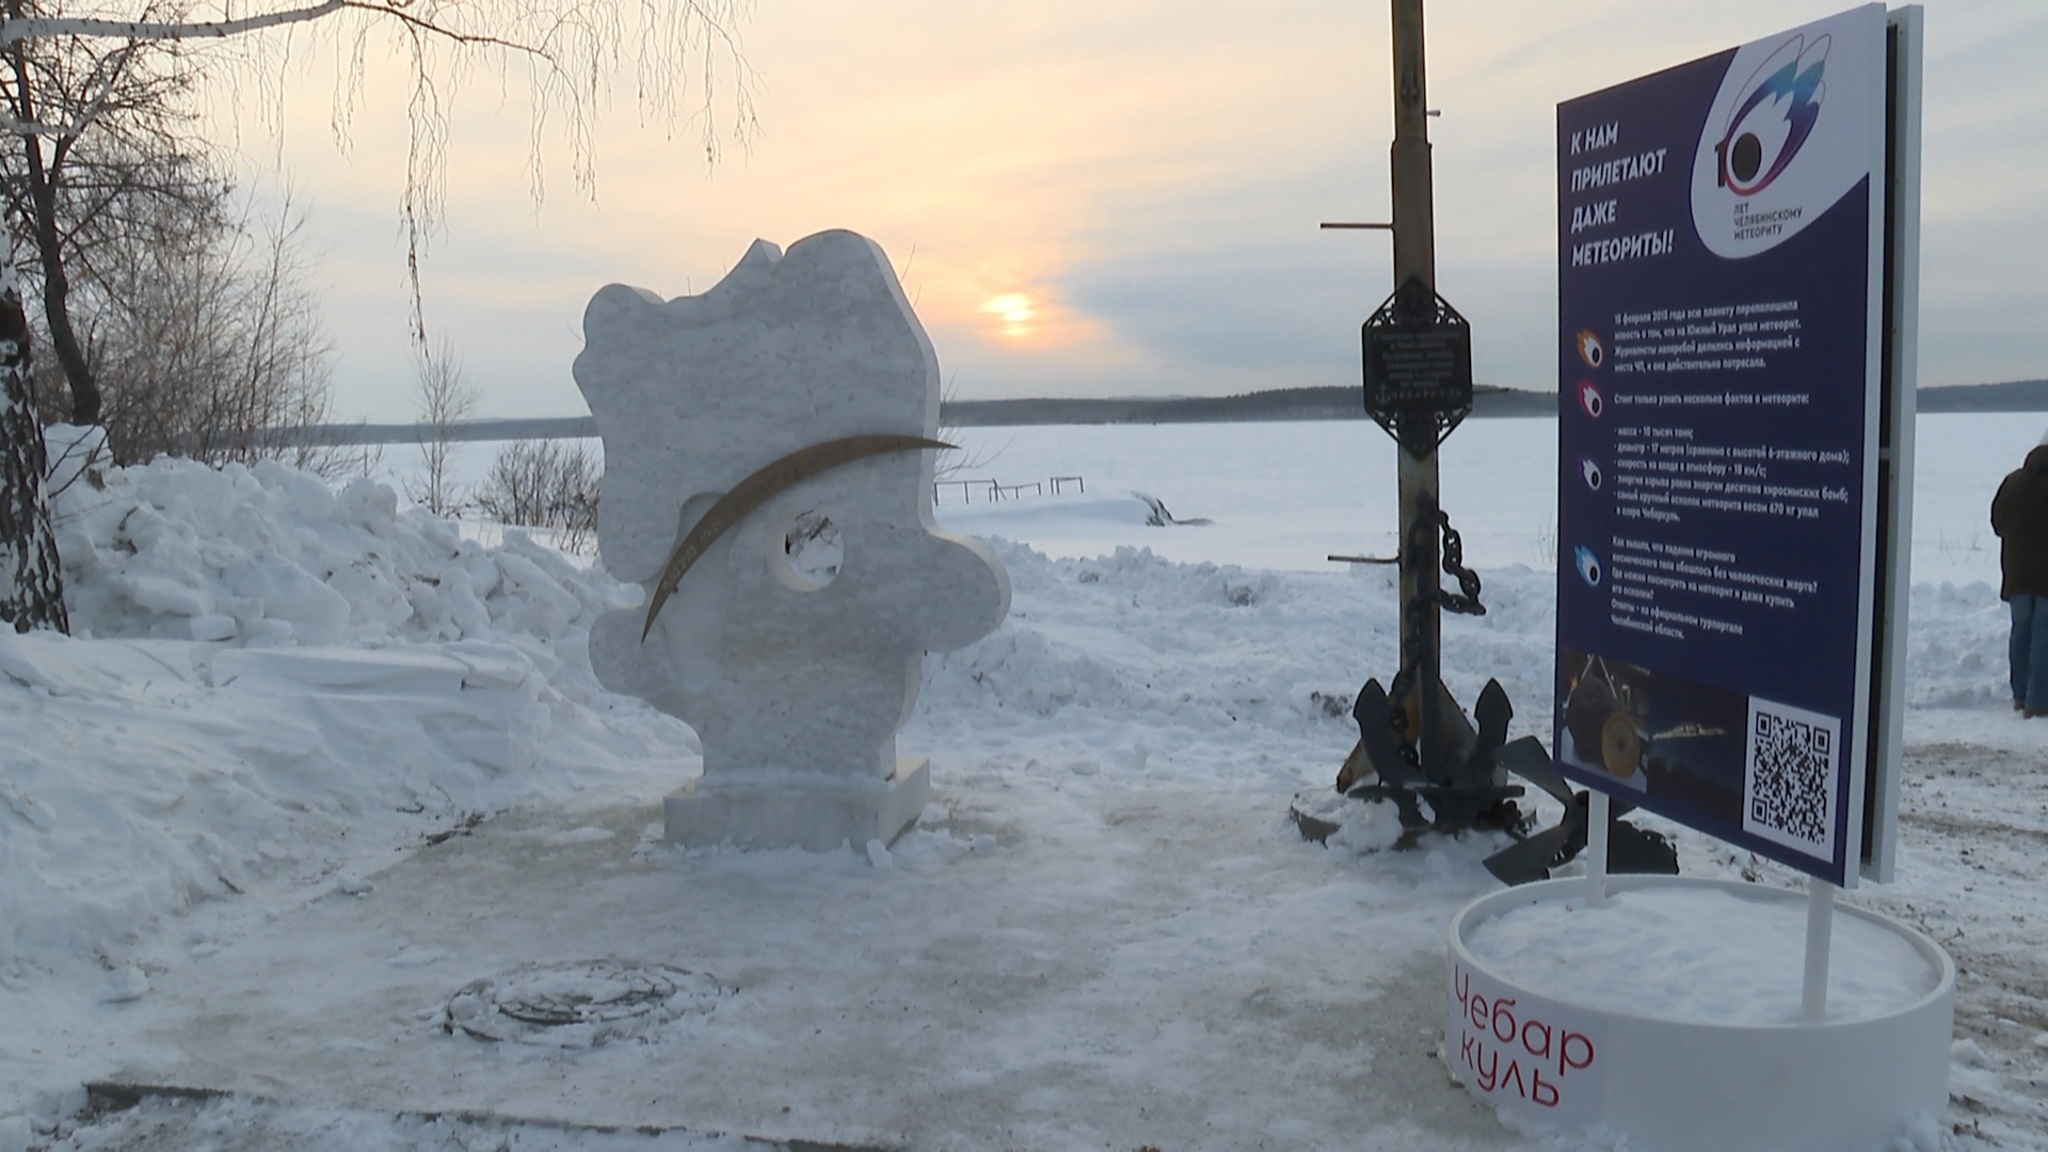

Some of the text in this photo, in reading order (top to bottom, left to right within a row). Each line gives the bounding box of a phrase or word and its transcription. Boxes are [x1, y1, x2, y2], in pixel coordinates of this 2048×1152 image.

[1571, 120, 1619, 156] К НАМ
[1571, 148, 1666, 192] ПРИЛЕТАЮТ
[1571, 199, 1617, 234] ДАЖЕ
[1733, 203, 1749, 215] ЛЕТ
[1734, 207, 1803, 227] ЧЕЛЯБИНСКОМУ
[1734, 224, 1783, 240] МЕТЕОРИТУ
[1572, 229, 1674, 267] МЕТЕОРИТЫ!
[1622, 312, 1651, 326] февраля
[1653, 309, 1667, 322] 2013
[1670, 309, 1685, 321] года
[1688, 308, 1701, 319] всю
[1704, 306, 1734, 318] планету
[1736, 300, 1798, 317] переполошила
[1614, 331, 1640, 340] новость
[1664, 328, 1675, 337] что
[1677, 327, 1685, 337] на
[1687, 321, 1716, 335] Южный
[1718, 322, 1736, 336] Урал
[1739, 322, 1758, 335] упал
[1760, 319, 1802, 332] метеорит.
[1614, 345, 1656, 359] Журналисты
[1697, 342, 1733, 354] делились
[1735, 334, 1792, 352] информацией
[1795, 338, 1800, 348] с
[1667, 357, 1721, 372] действительно
[1614, 390, 1809, 407] Стоит только узнать несколько фактов о метеорите:
[1618, 427, 1637, 436] масса
[1643, 426, 1650, 436] 10
[1652, 428, 1673, 437] тысяч
[1618, 443, 1645, 455] диаметр
[1652, 442, 1659, 453] 17
[1660, 445, 1684, 456] метров
[1727, 447, 1731, 456] с
[1733, 445, 1766, 458] высотой
[1768, 446, 1817, 461] 6-этажного
[1819, 449, 1849, 465] дома);
[1618, 459, 1647, 470] скорость
[1686, 461, 1726, 476] атмосферу
[1734, 463, 1742, 475] 18
[1744, 463, 1766, 479] км/с;
[1617, 488, 1638, 500] самый
[1640, 491, 1669, 504] крупный
[1702, 498, 1741, 511] метеорита
[1744, 502, 1767, 513] весом
[1770, 502, 1784, 515] 670
[1786, 506, 1795, 515] кг
[1797, 507, 1819, 519] упал
[1671, 478, 1691, 489] равна
[1694, 480, 1724, 493] энергии
[1724, 482, 1761, 494] десятков
[1822, 486, 1848, 504] бомб;
[1613, 536, 1624, 547] Как
[1652, 543, 1662, 552] что
[1665, 544, 1694, 556] падение
[1696, 548, 1735, 563] огромного
[1612, 553, 1818, 593] космического тела обошлось без человеческих жертв?
[1624, 571, 1645, 582] можно
[1647, 574, 1686, 589] посмотреть
[1688, 581, 1697, 591] на
[1698, 583, 1733, 598] метеорит
[1735, 589, 1740, 598] и
[1741, 590, 1763, 603] даже
[1765, 594, 1794, 608] купить
[1611, 598, 1635, 612] Ответы
[1641, 606, 1649, 615] на
[1651, 606, 1697, 625] официальном
[1700, 617, 1743, 636] турпортале
[1611, 614, 1653, 632] Челябинской
[1455, 964, 1594, 1077] Чебар
[1461, 1029, 1560, 1107] куль
